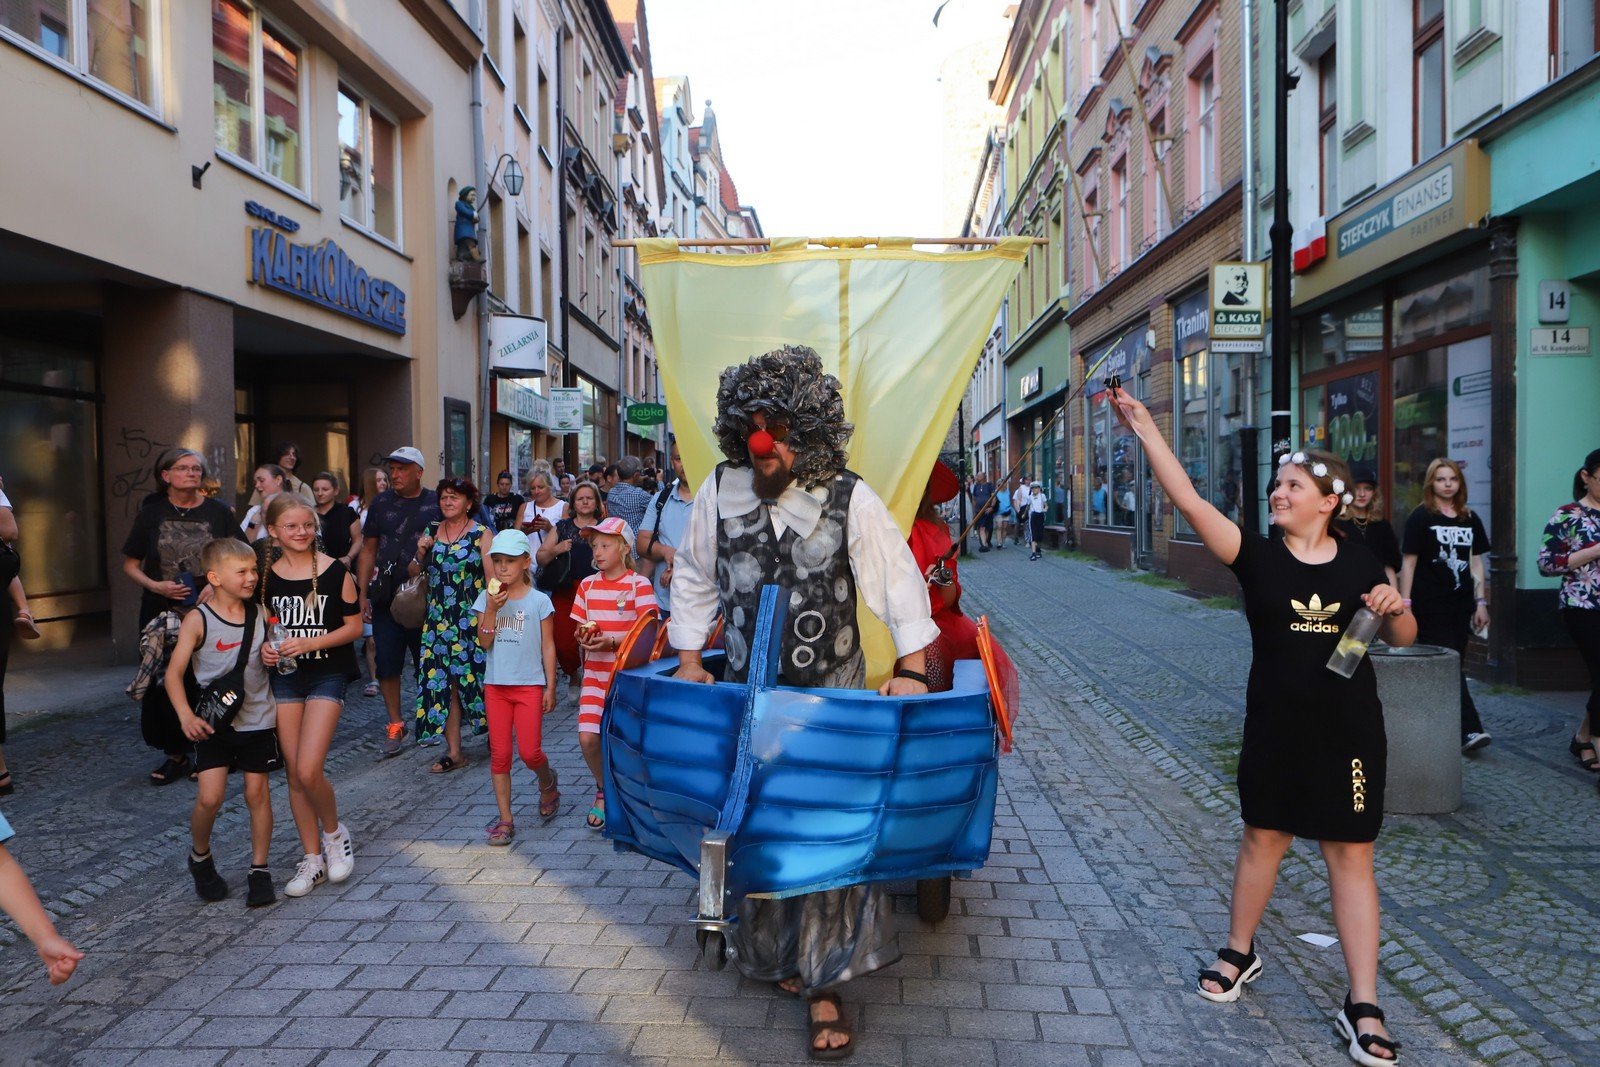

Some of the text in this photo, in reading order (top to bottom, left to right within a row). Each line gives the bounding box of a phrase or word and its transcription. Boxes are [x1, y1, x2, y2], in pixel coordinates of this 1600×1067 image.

[245, 200, 300, 233] SKLEP
[1340, 174, 1448, 251] STEFCZYK FINANSE
[1411, 207, 1454, 239] PARTNER
[252, 228, 406, 330] KARKONOSZE
[1549, 291, 1566, 309] 14
[1176, 308, 1209, 340] Tkaniny
[1215, 324, 1259, 334] STEFCZYKA
[1228, 313, 1259, 323] KASY
[498, 330, 540, 358] ZIELARNIA
[1552, 329, 1571, 344] 14
[631, 407, 664, 417] żabka
[272, 594, 329, 627] TODAY
[1290, 621, 1339, 633] adidas
[1351, 758, 1367, 813] adidas
